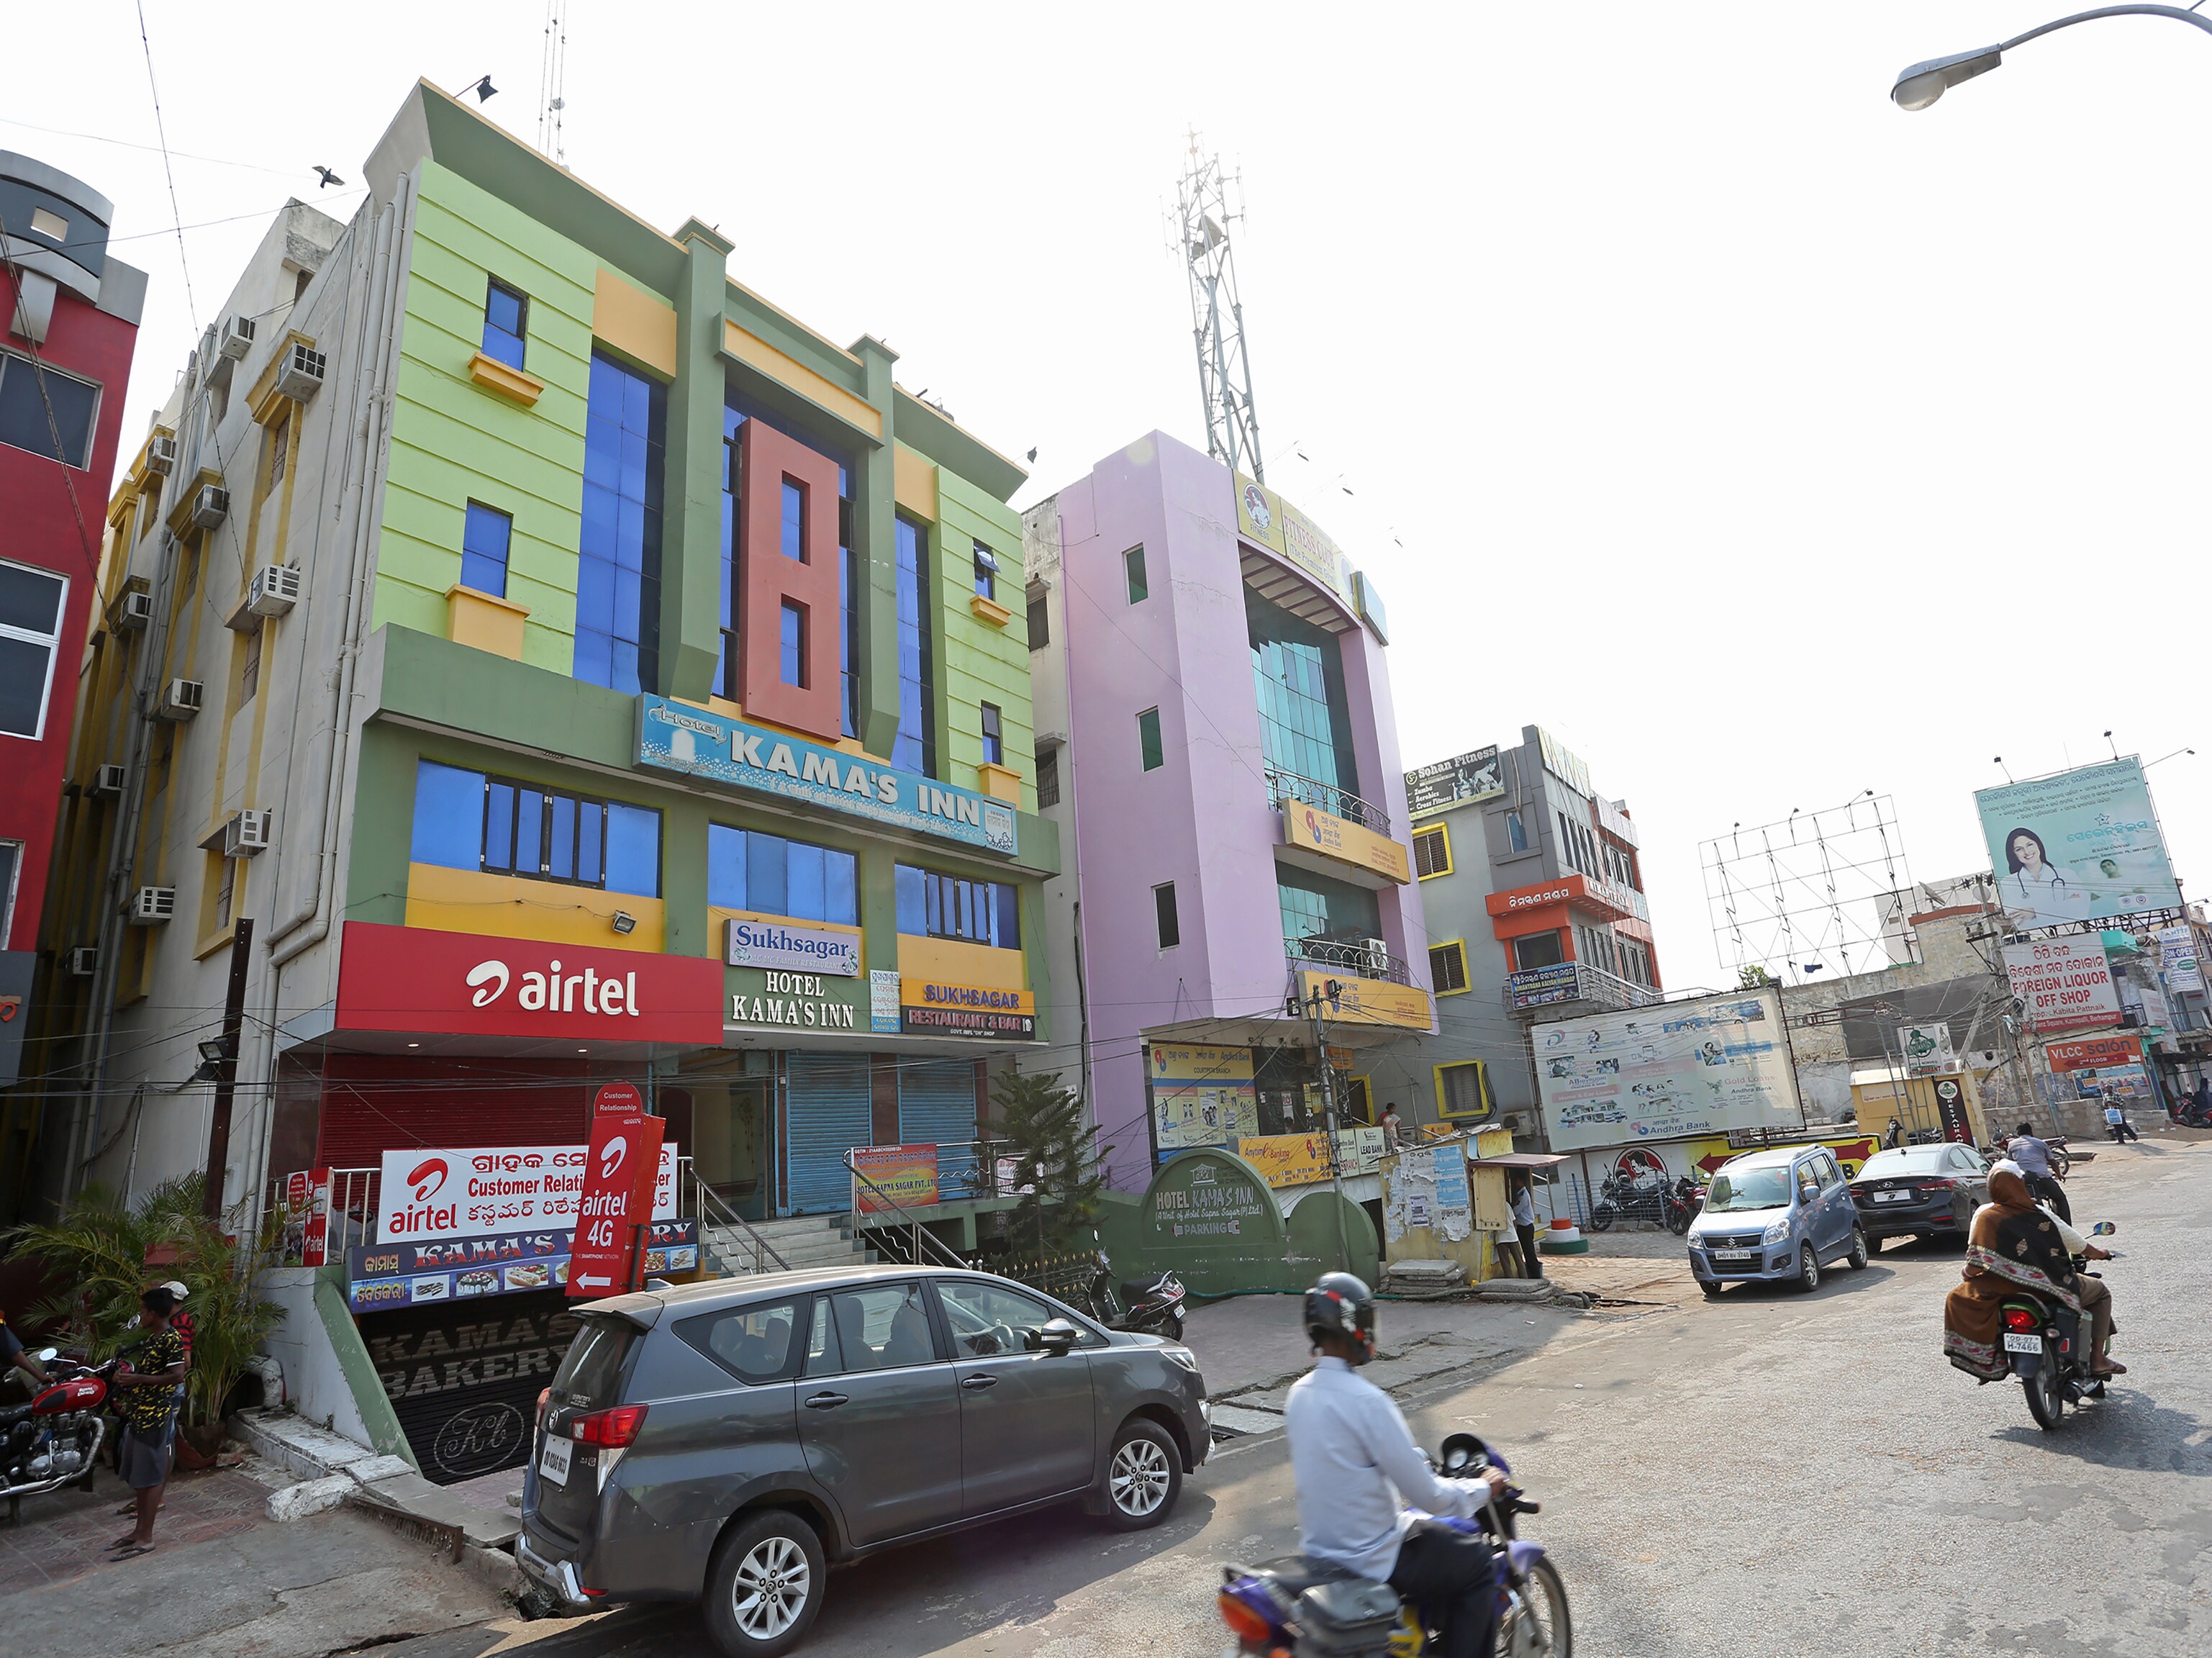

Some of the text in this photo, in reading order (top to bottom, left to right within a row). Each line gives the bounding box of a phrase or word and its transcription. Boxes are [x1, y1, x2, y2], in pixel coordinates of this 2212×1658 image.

[1250, 523, 1270, 540] FITNESS
[661, 710, 721, 736] Hotel
[1418, 747, 1497, 779] Sohan Fitness
[730, 729, 979, 827] KAMA'S INN
[1414, 786, 1433, 795] Zumba
[1415, 792, 1439, 803] Aerobics
[1417, 796, 1452, 810] Cross Fitness
[736, 925, 848, 959] Sukhsagar
[776, 957, 801, 966] FAMILY
[802, 959, 842, 971] RESTAURANT
[518, 959, 640, 1017] airtel
[766, 971, 825, 997] HOTEL
[2013, 971, 2109, 995] FOREIGN LIQUOR
[925, 984, 1020, 1009] SUKHSAGAR
[2036, 989, 2090, 1007] OFF SHOP
[733, 995, 854, 1028] KAMA'S INN
[2077, 1004, 2106, 1013] Pattnaik
[2090, 1013, 2117, 1022] Berhampur
[909, 1010, 1021, 1031] RESTAURANT & BAR
[1220, 1052, 1238, 1061] Andhra
[2052, 1046, 2083, 1059] VLCC
[1650, 1123, 1684, 1134] Andhra
[1686, 1120, 1710, 1131] Bank
[1947, 1099, 1963, 1143] RESTAURAN
[1360, 1144, 1383, 1154] LEAD BANK
[471, 1153, 544, 1173] ଗ୍ରାହକ
[468, 1174, 584, 1197] Customer Relati
[876, 1183, 894, 1192] SAPNA
[896, 1181, 913, 1190] SAGAR
[582, 1189, 627, 1216] airtel
[1156, 1186, 1254, 1210] HOTEL KAMA'S INN
[389, 1203, 458, 1234] airtel
[468, 1200, 535, 1226] కస్టమర్
[1163, 1211, 1174, 1220] Unit
[1177, 1211, 1183, 1222] of
[1184, 1209, 1200, 1219] Hotel
[1201, 1208, 1220, 1220] Sapna
[587, 1220, 614, 1248] 4G
[1184, 1222, 1226, 1236] PARKING
[310, 1235, 324, 1252] airtel
[414, 1233, 555, 1269] KAMA'S
[365, 1254, 399, 1274] କାମାସ୍
[2008, 1342, 2039, 1351] H-7466
